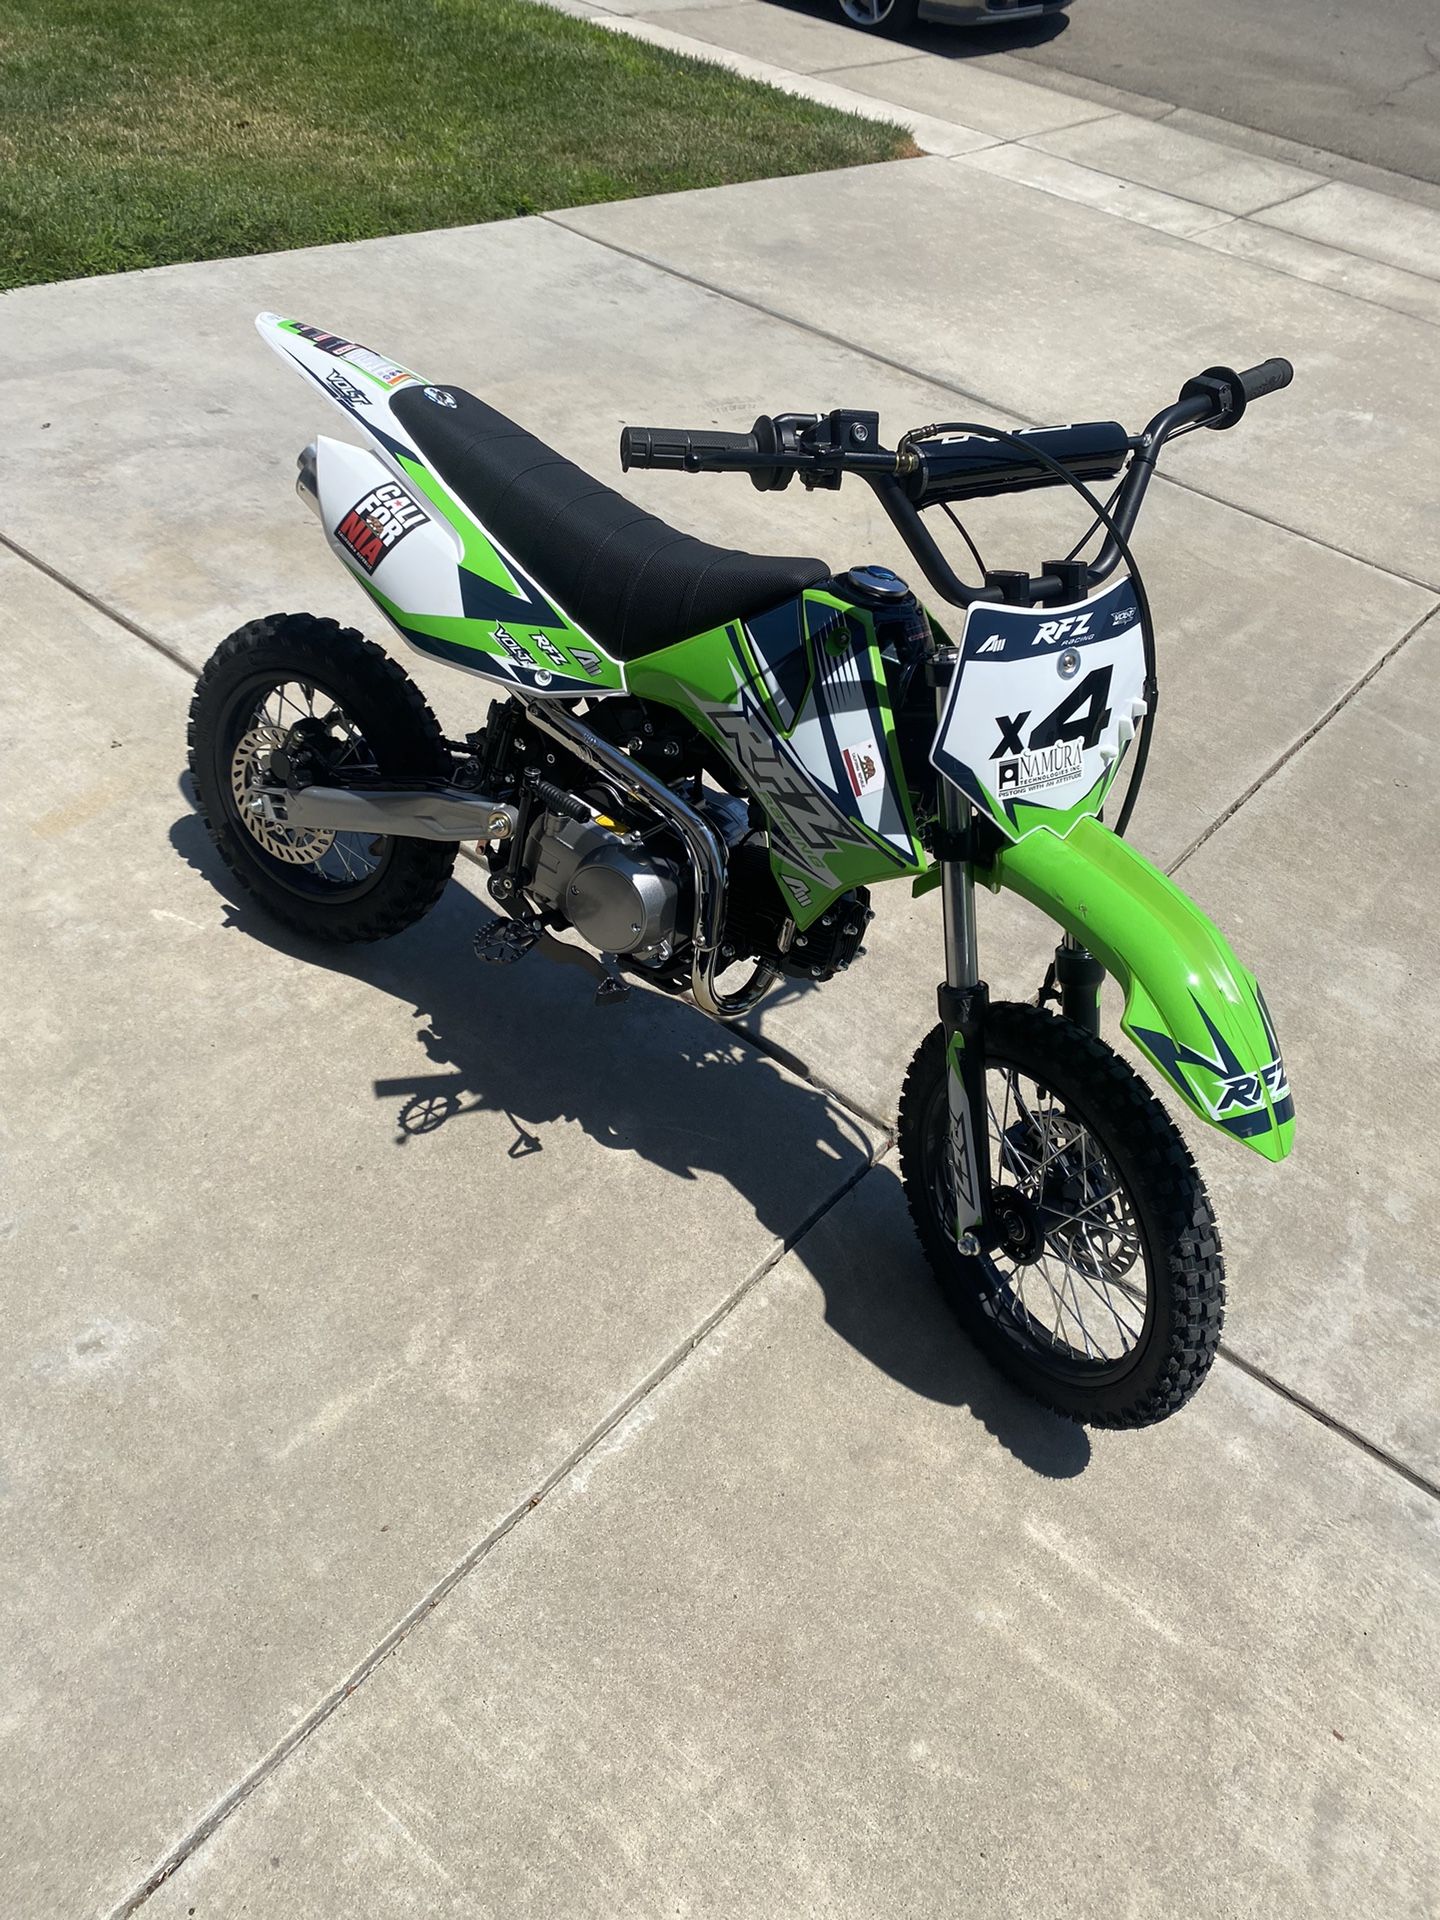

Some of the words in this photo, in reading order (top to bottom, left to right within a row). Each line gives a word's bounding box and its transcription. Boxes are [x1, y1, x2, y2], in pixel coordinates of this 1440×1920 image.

[325, 368, 373, 406] VOLT
[355, 493, 404, 547] FOR
[375, 484, 426, 530] CALI
[341, 510, 384, 567] NIA
[494, 622, 538, 667] VOLT
[528, 629, 571, 667] RFZ
[1031, 612, 1095, 646] RFZ
[706, 688, 869, 850] RFZ
[1020, 742, 1083, 780] NAMURA
[1020, 769, 1069, 786] TECHNOLOGIES
[998, 786, 1027, 798] PISTONS
[1028, 783, 1045, 792] WITH
[1055, 772, 1083, 785] ATTITUDE
